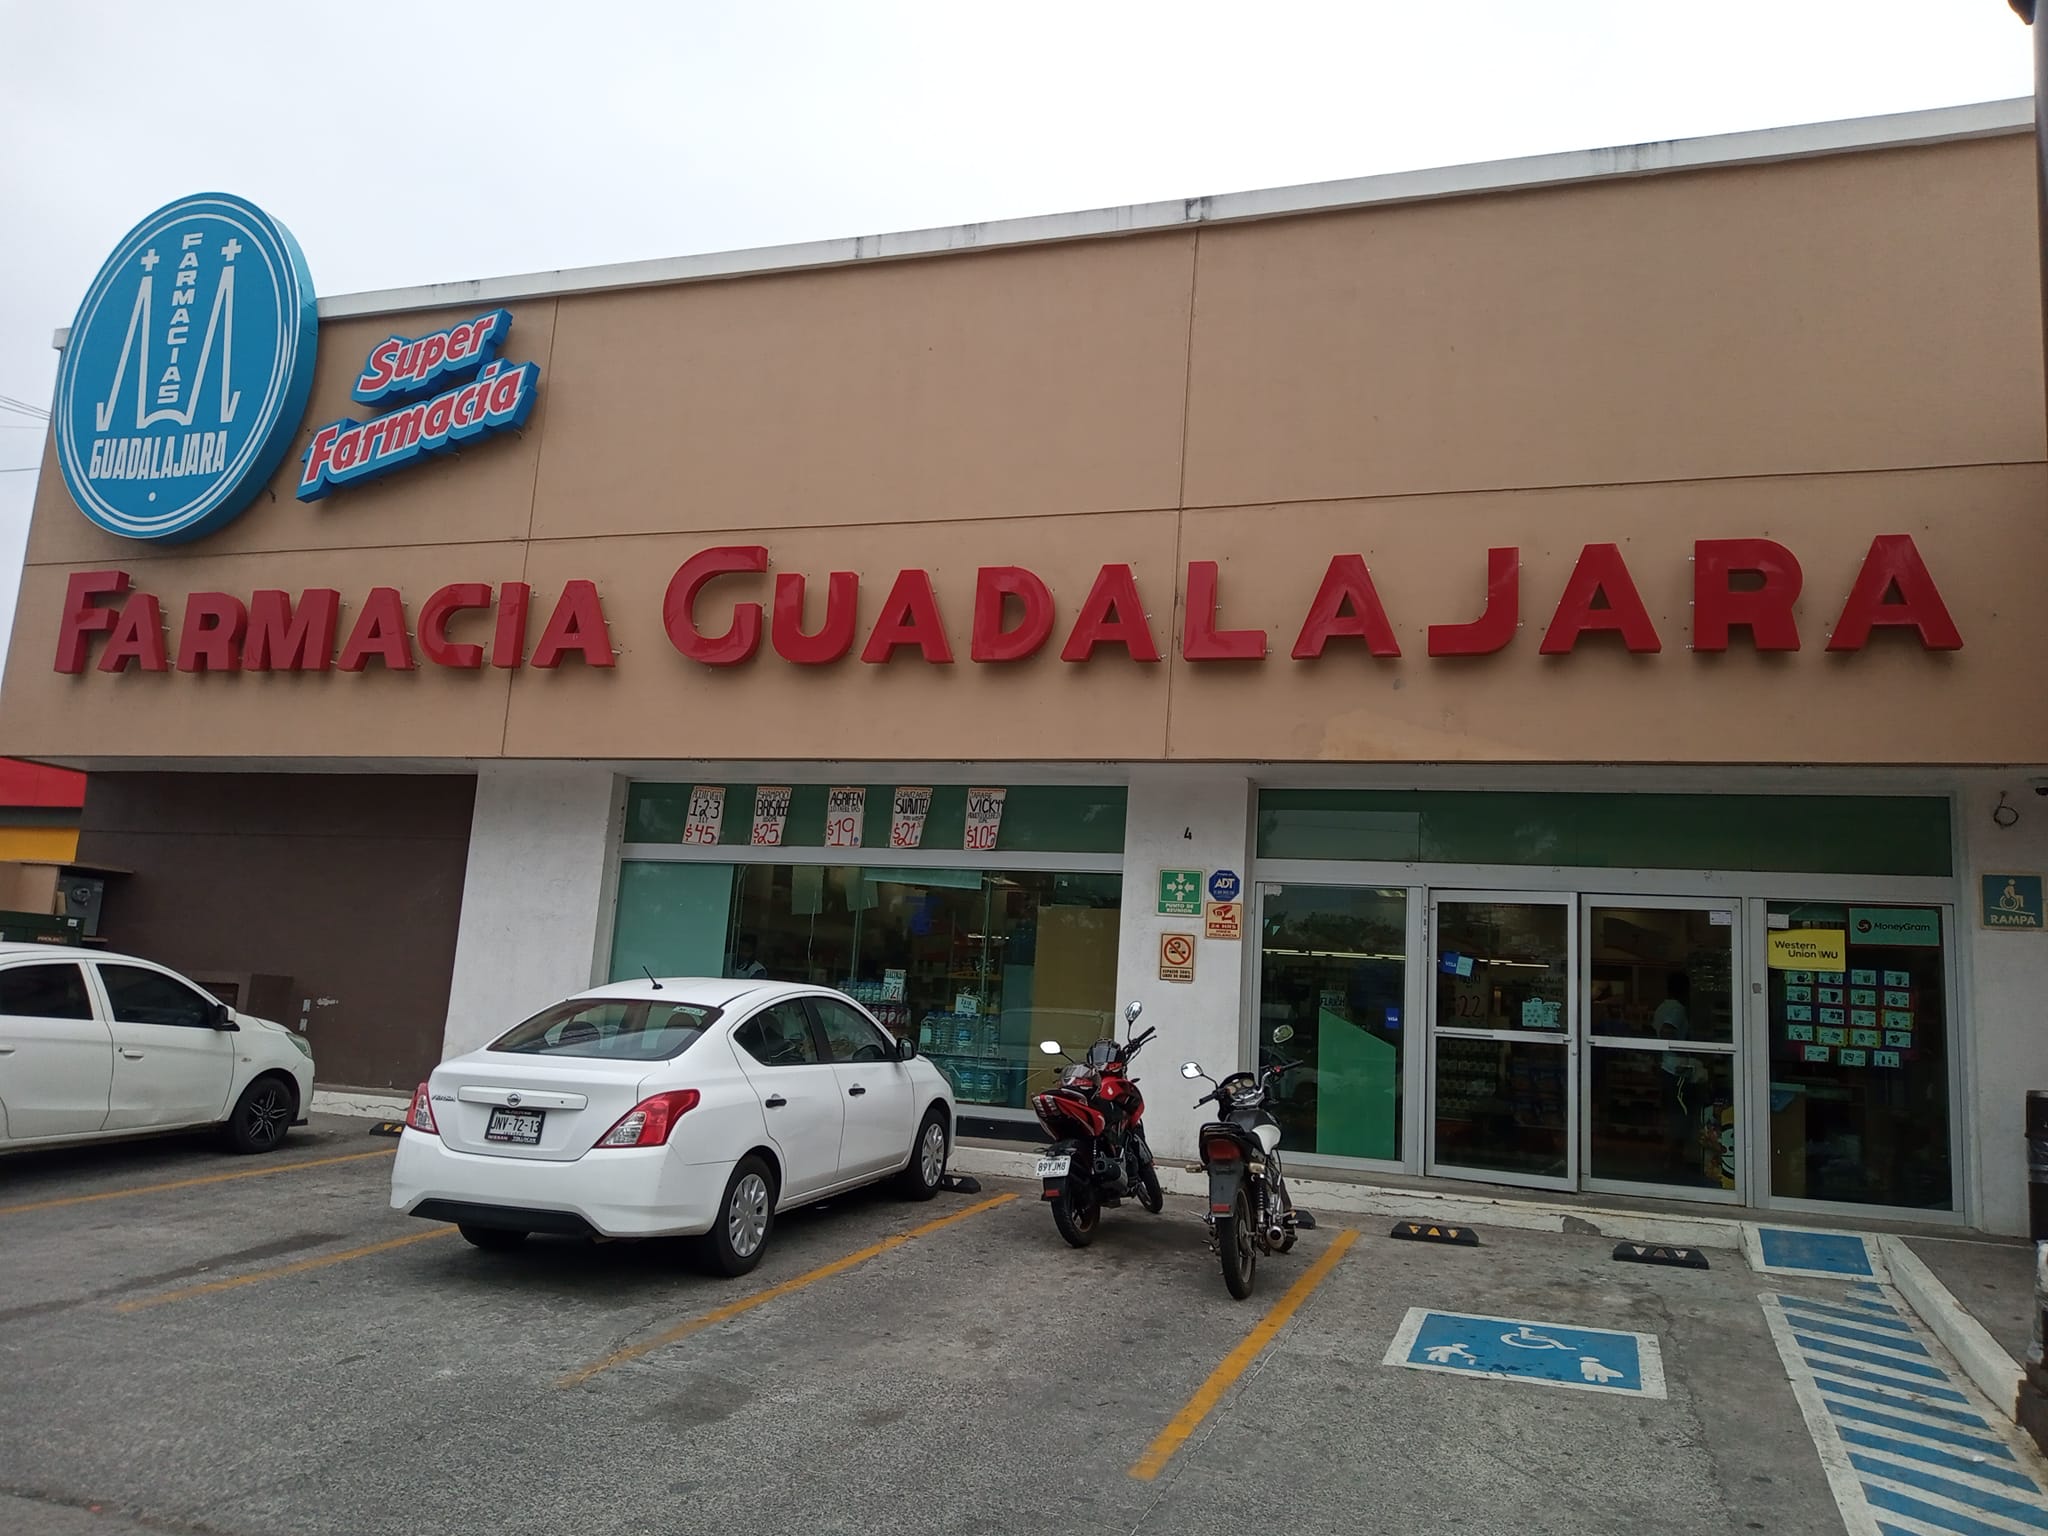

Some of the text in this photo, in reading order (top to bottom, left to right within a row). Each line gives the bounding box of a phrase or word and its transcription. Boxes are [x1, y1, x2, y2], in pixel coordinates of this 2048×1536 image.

[157, 232, 203, 404] FARMACIAS
[357, 311, 495, 394] Super
[304, 362, 523, 484] Farmacia
[89, 430, 226, 481] GUADALAJARA
[53, 533, 1964, 675] FARMACIA GUADALAJARA
[685, 824, 717, 845] $45
[753, 823, 780, 845] $25
[966, 824, 998, 849] $105
[1183, 827, 1193, 840] 4
[1214, 878, 1235, 889] ADT
[1873, 922, 1930, 933] MoneyGram
[1990, 914, 2036, 925] RAMPA
[1774, 940, 1817, 950] Western
[1788, 949, 1817, 959] Union
[1445, 960, 1457, 968] VISA
[490, 1116, 541, 1133] JNV-72-13
